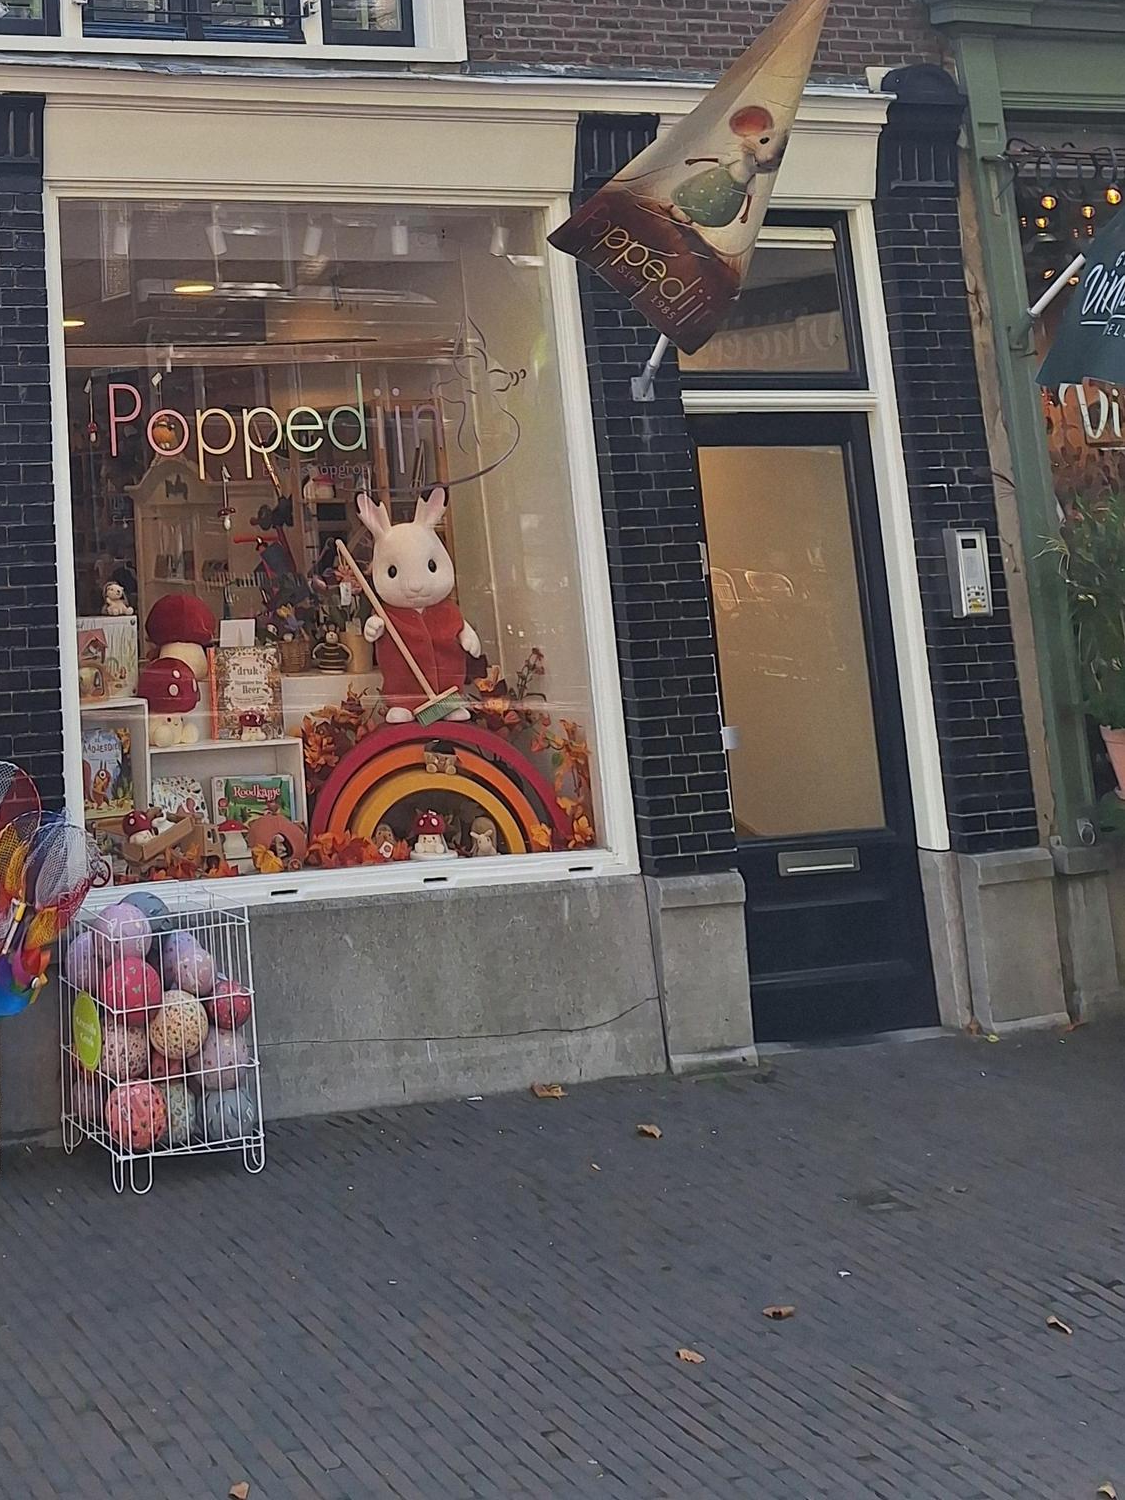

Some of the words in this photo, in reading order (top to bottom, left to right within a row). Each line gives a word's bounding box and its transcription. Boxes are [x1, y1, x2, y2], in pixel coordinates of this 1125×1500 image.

[649, 294, 677, 321] 1985
[106, 371, 446, 481] Poppedijn
[233, 784, 281, 801] Roodkapje
